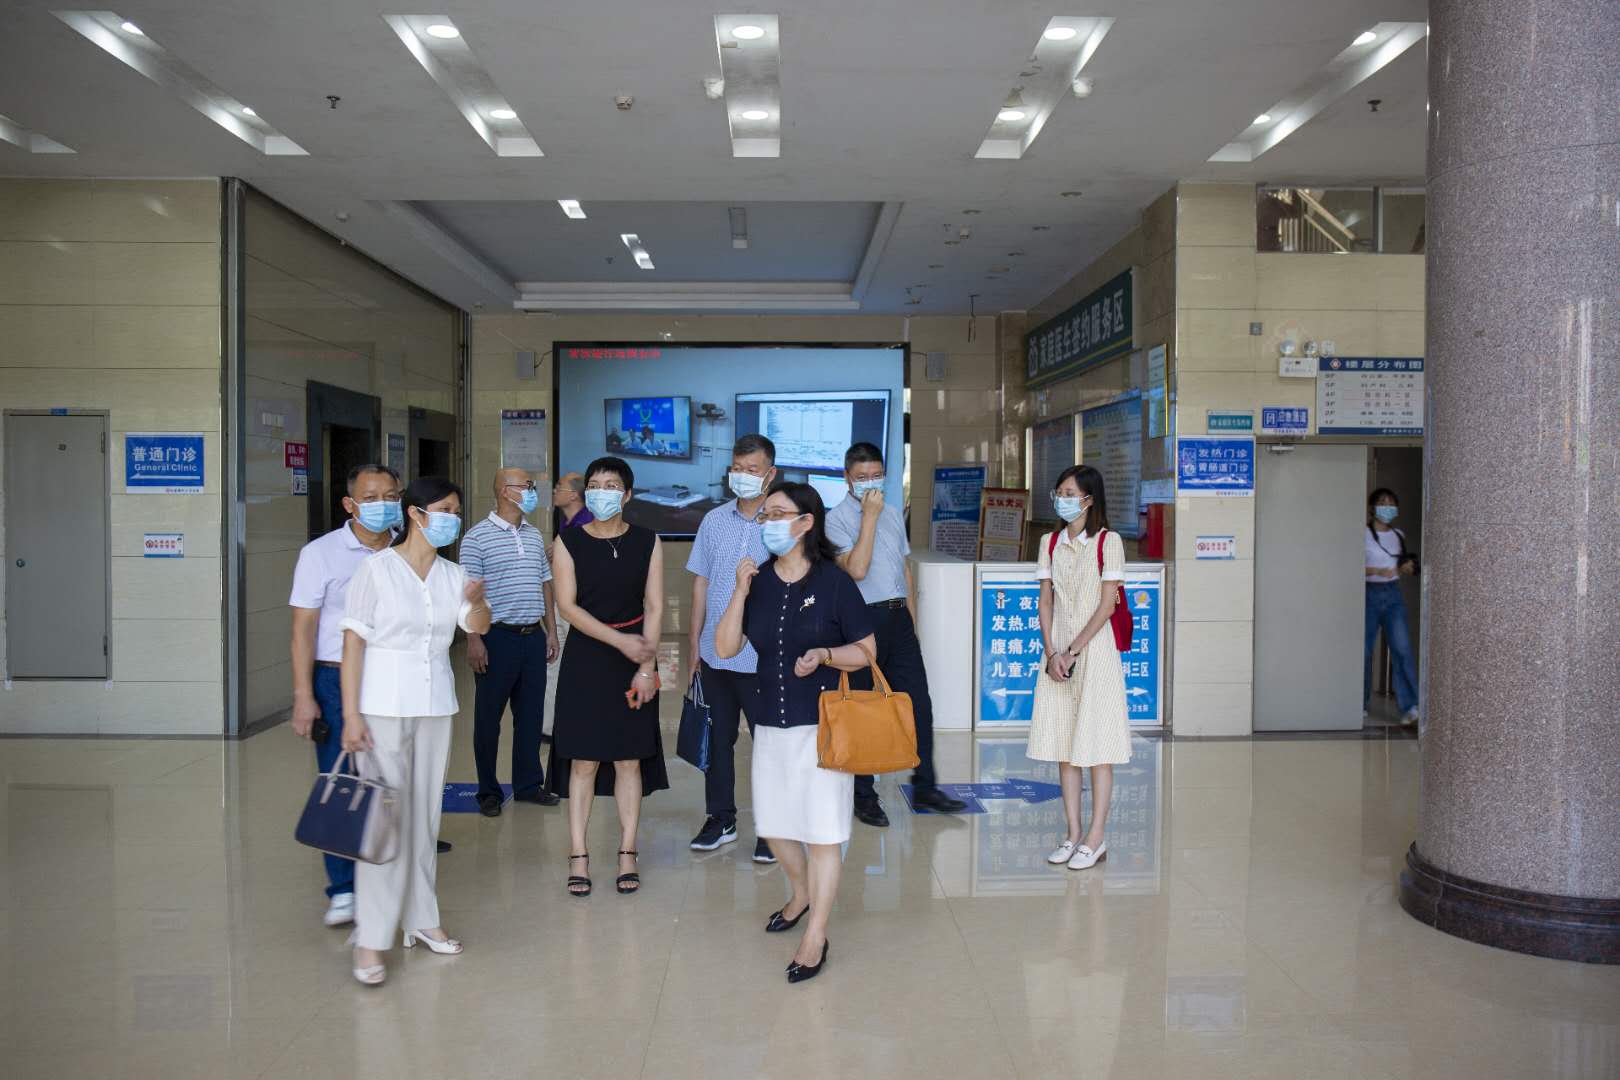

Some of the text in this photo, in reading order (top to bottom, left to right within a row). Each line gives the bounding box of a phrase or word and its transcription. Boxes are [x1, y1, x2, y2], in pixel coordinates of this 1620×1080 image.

[132, 446, 197, 463] 普通门诊
[1198, 447, 1248, 459] 发热门诊
[134, 463, 198, 472] General Clinic
